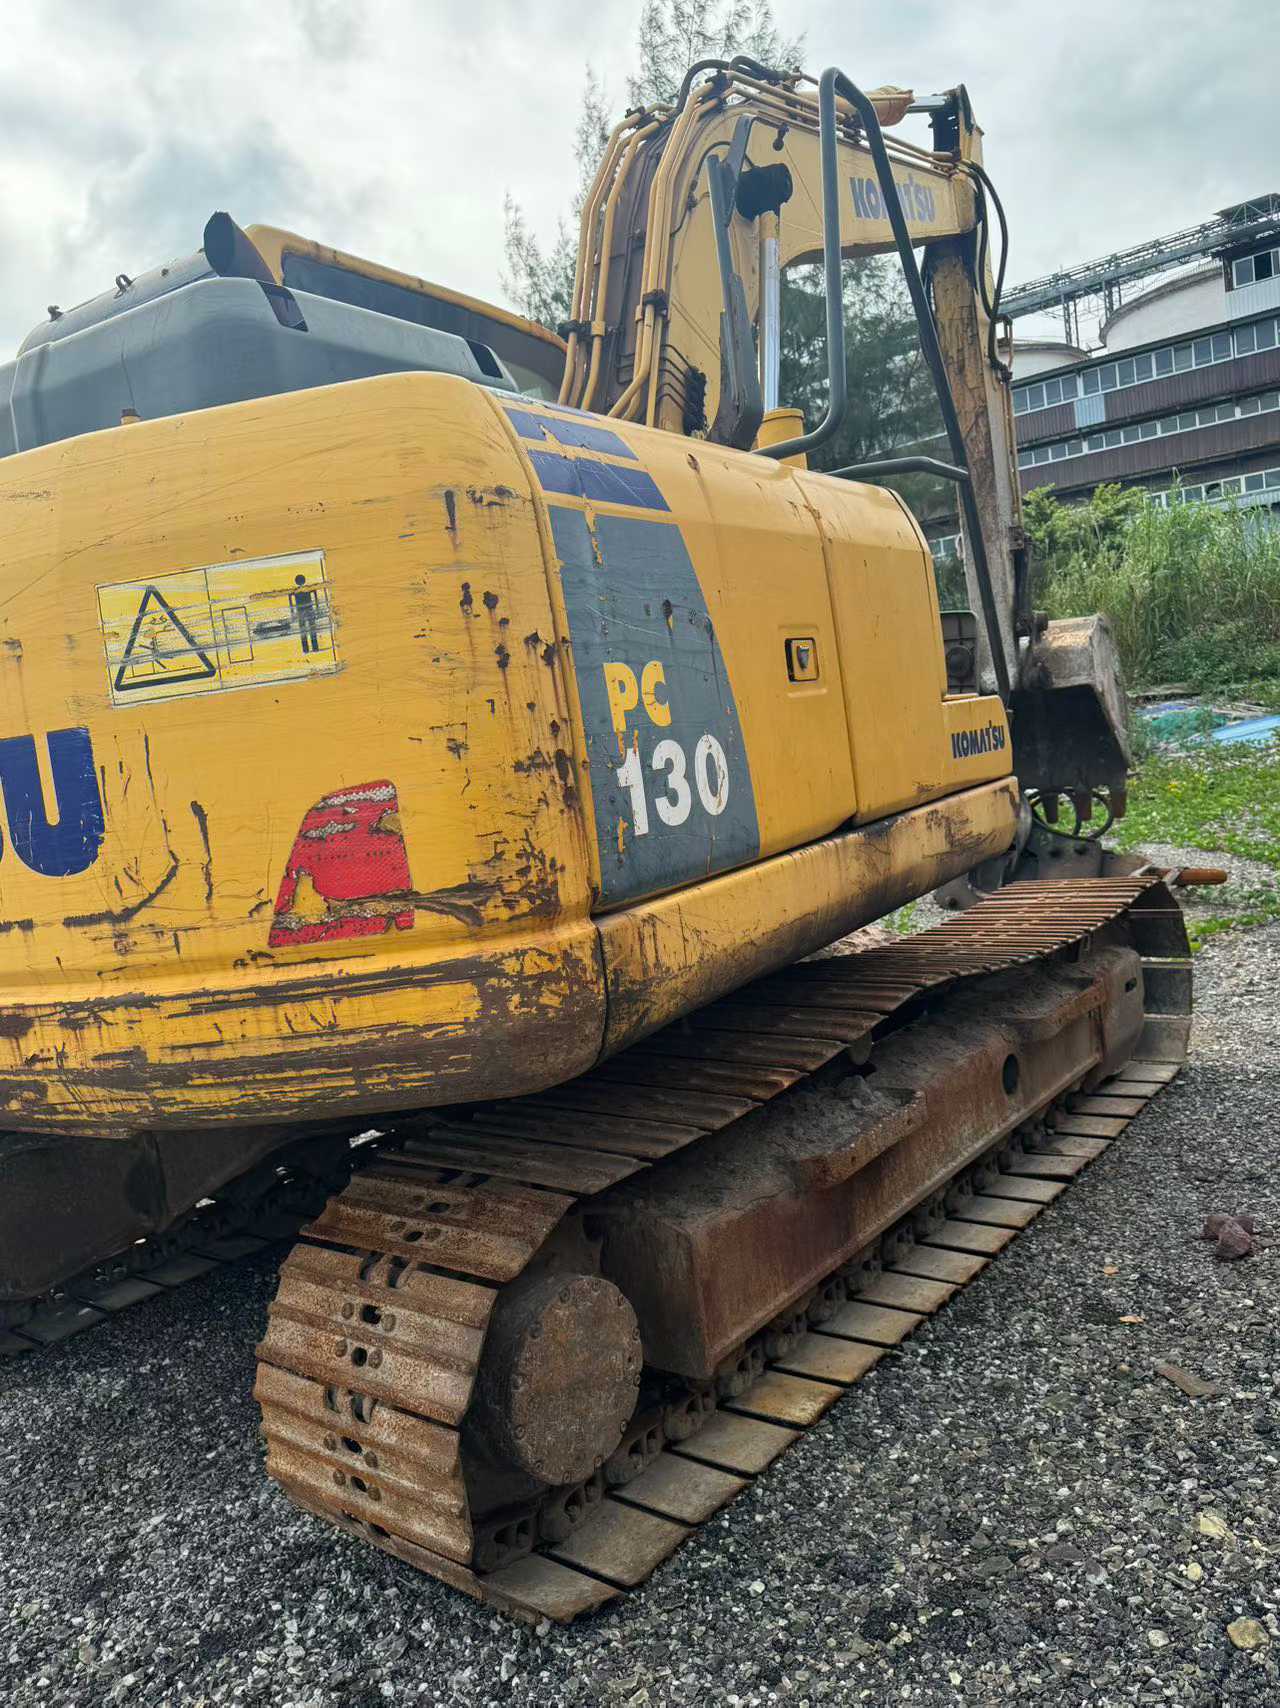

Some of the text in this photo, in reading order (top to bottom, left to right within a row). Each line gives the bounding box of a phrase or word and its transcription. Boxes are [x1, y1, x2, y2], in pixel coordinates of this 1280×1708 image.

[603, 660, 672, 733] PC
[951, 719, 1005, 759] KOMATSU
[0, 727, 105, 878] U
[616, 734, 729, 836] 130
